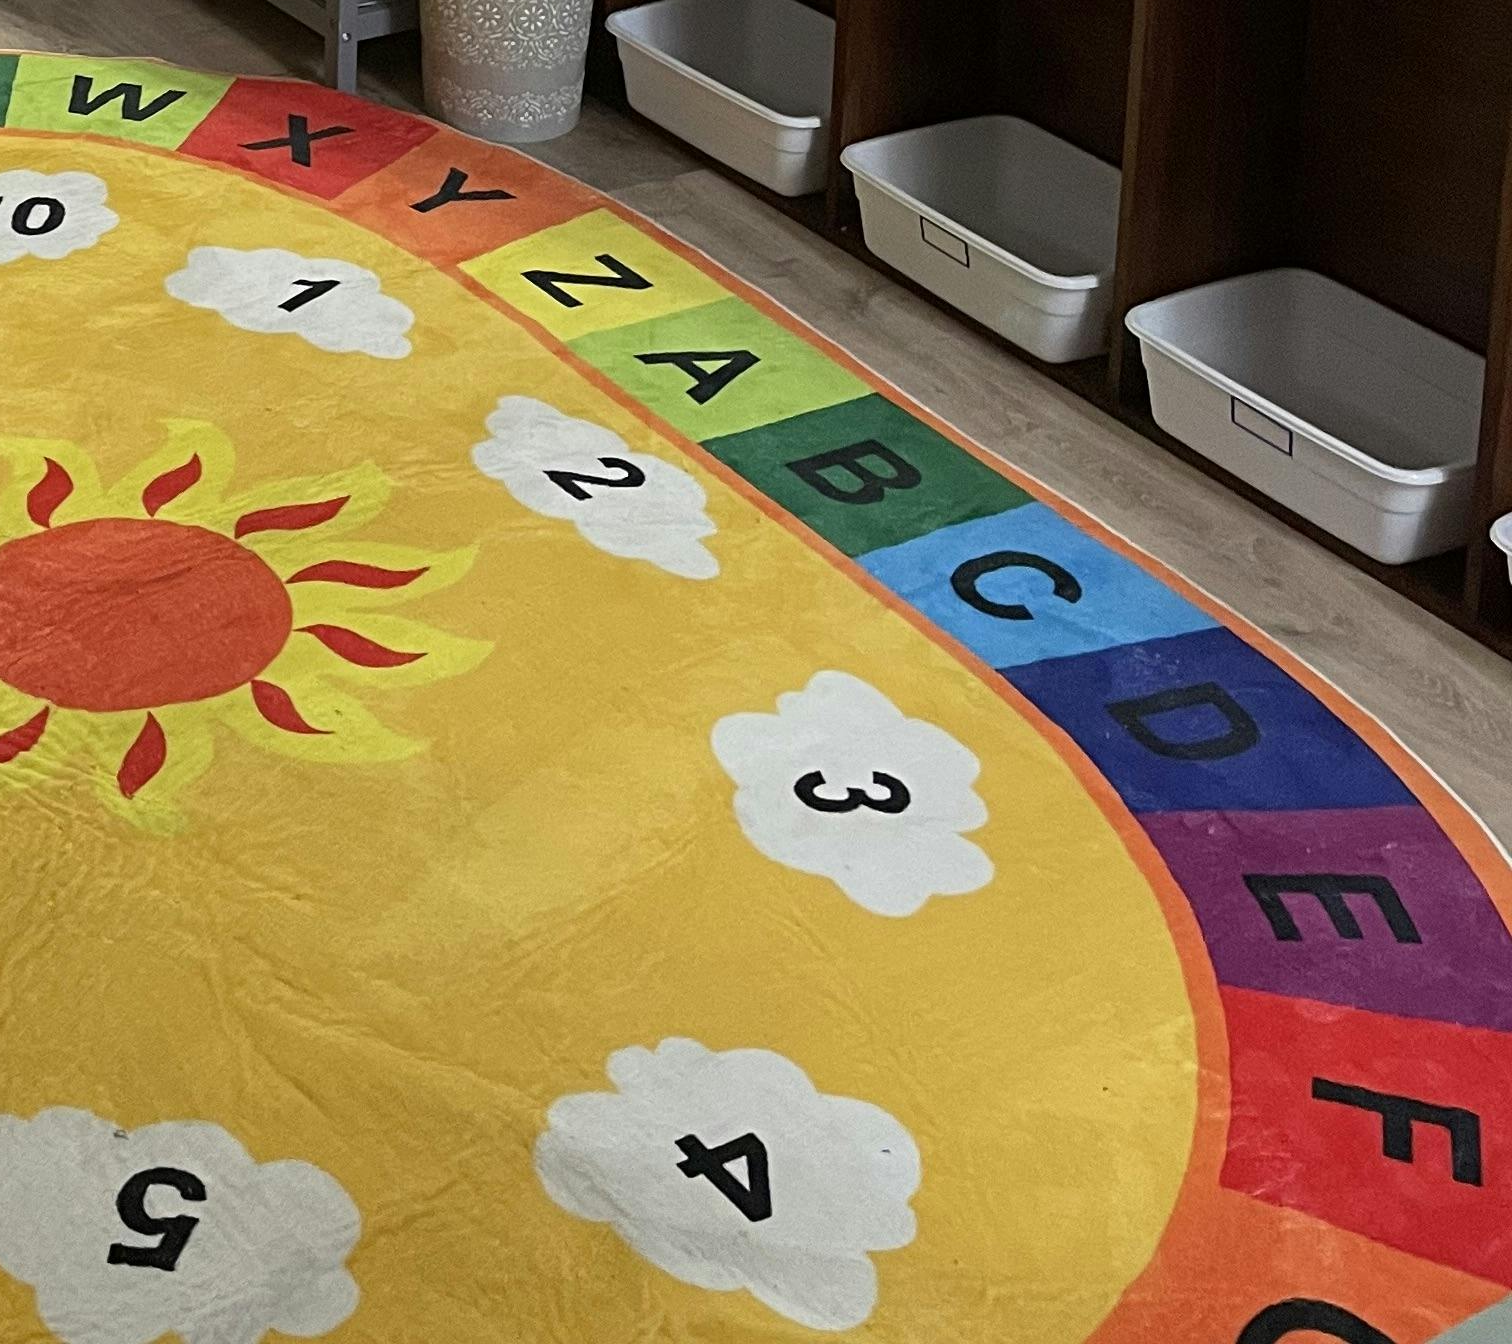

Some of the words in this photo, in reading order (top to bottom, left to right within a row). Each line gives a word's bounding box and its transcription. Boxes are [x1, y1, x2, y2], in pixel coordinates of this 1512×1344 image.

[67, 74, 188, 122] W
[238, 113, 357, 167] X
[409, 168, 518, 212] Y
[278, 278, 341, 312] 1
[521, 253, 654, 309] Z
[633, 349, 762, 405] A
[542, 457, 647, 501] 2
[786, 438, 923, 505] B
[950, 550, 1083, 622] C
[1103, 680, 1261, 762] D
[793, 769, 911, 816] 3
[1241, 873, 1424, 945] E
[1311, 1075, 1486, 1188] F
[673, 1130, 774, 1223] 4
[106, 1165, 208, 1273] 5
